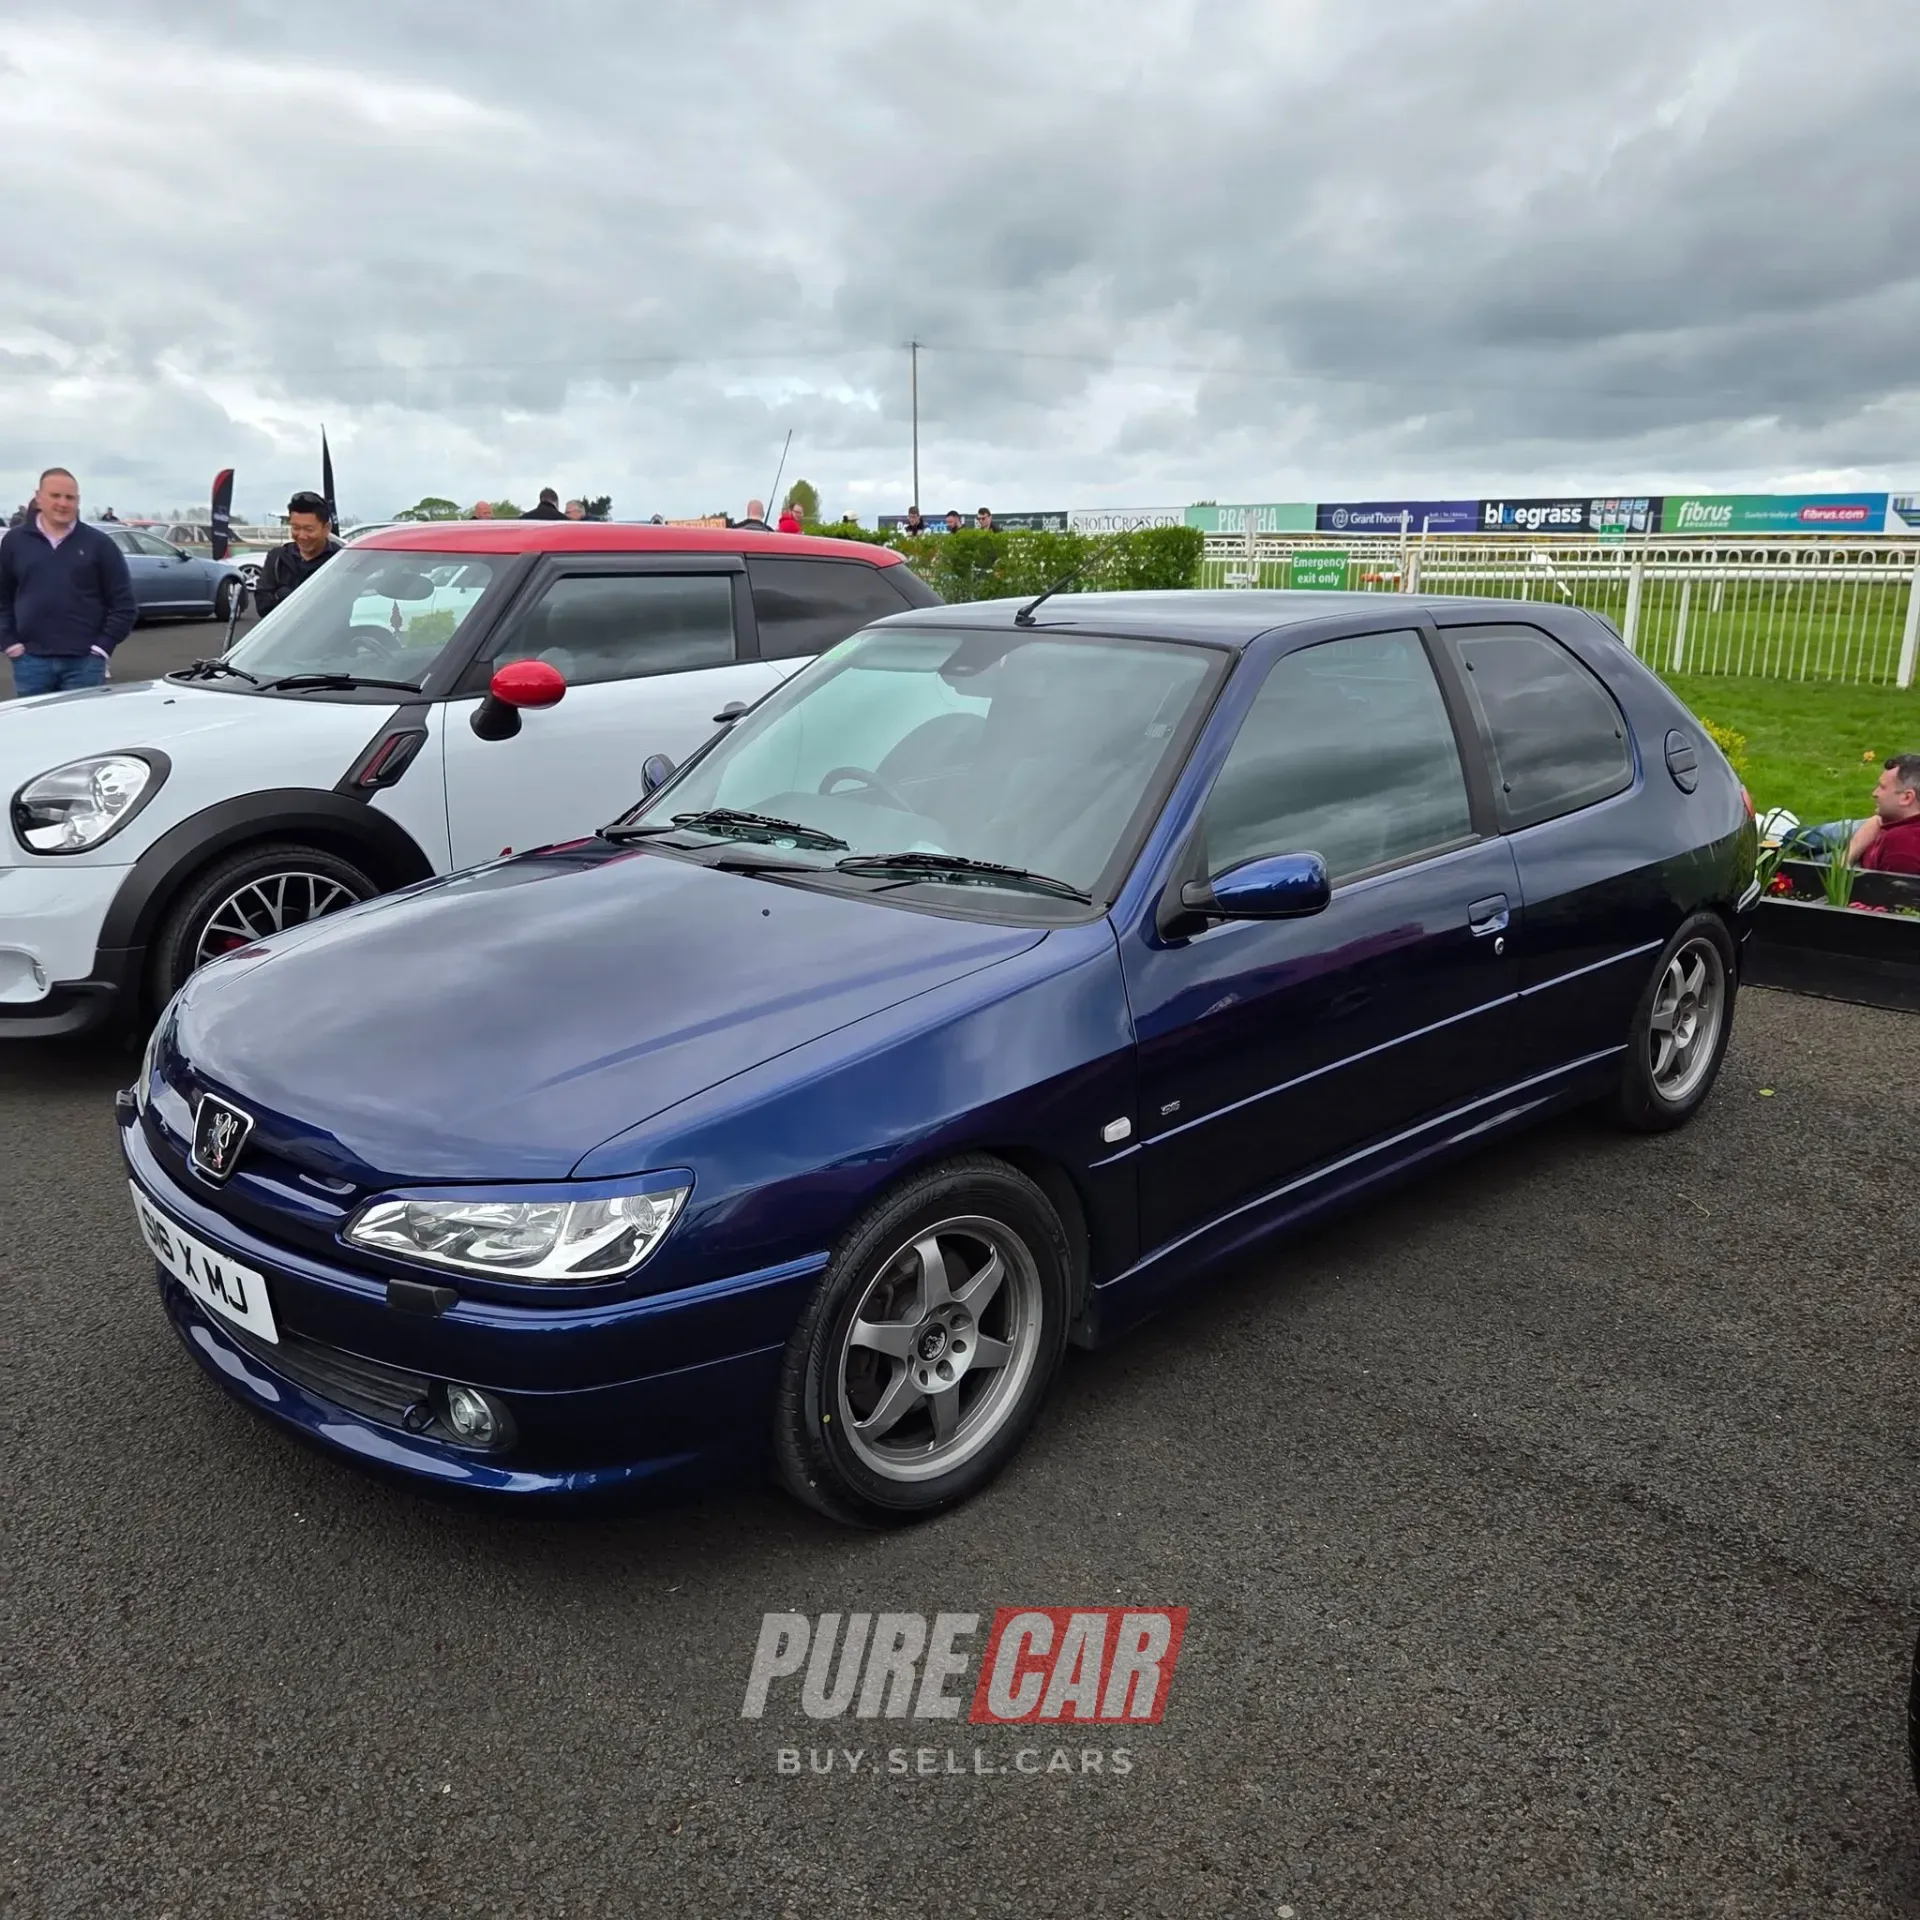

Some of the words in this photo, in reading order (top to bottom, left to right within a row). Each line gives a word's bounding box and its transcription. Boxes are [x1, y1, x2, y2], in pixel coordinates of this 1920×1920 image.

[1218, 508, 1277, 532] PRAHA
[1375, 512, 1414, 524] Thorntn
[1484, 503, 1583, 530] bluegrass
[1676, 501, 1733, 528] fibrus
[1803, 508, 1865, 520] fibrus.com
[1293, 556, 1347, 570] Emergency
[1297, 571, 1316, 583] exit
[1318, 571, 1340, 586] only
